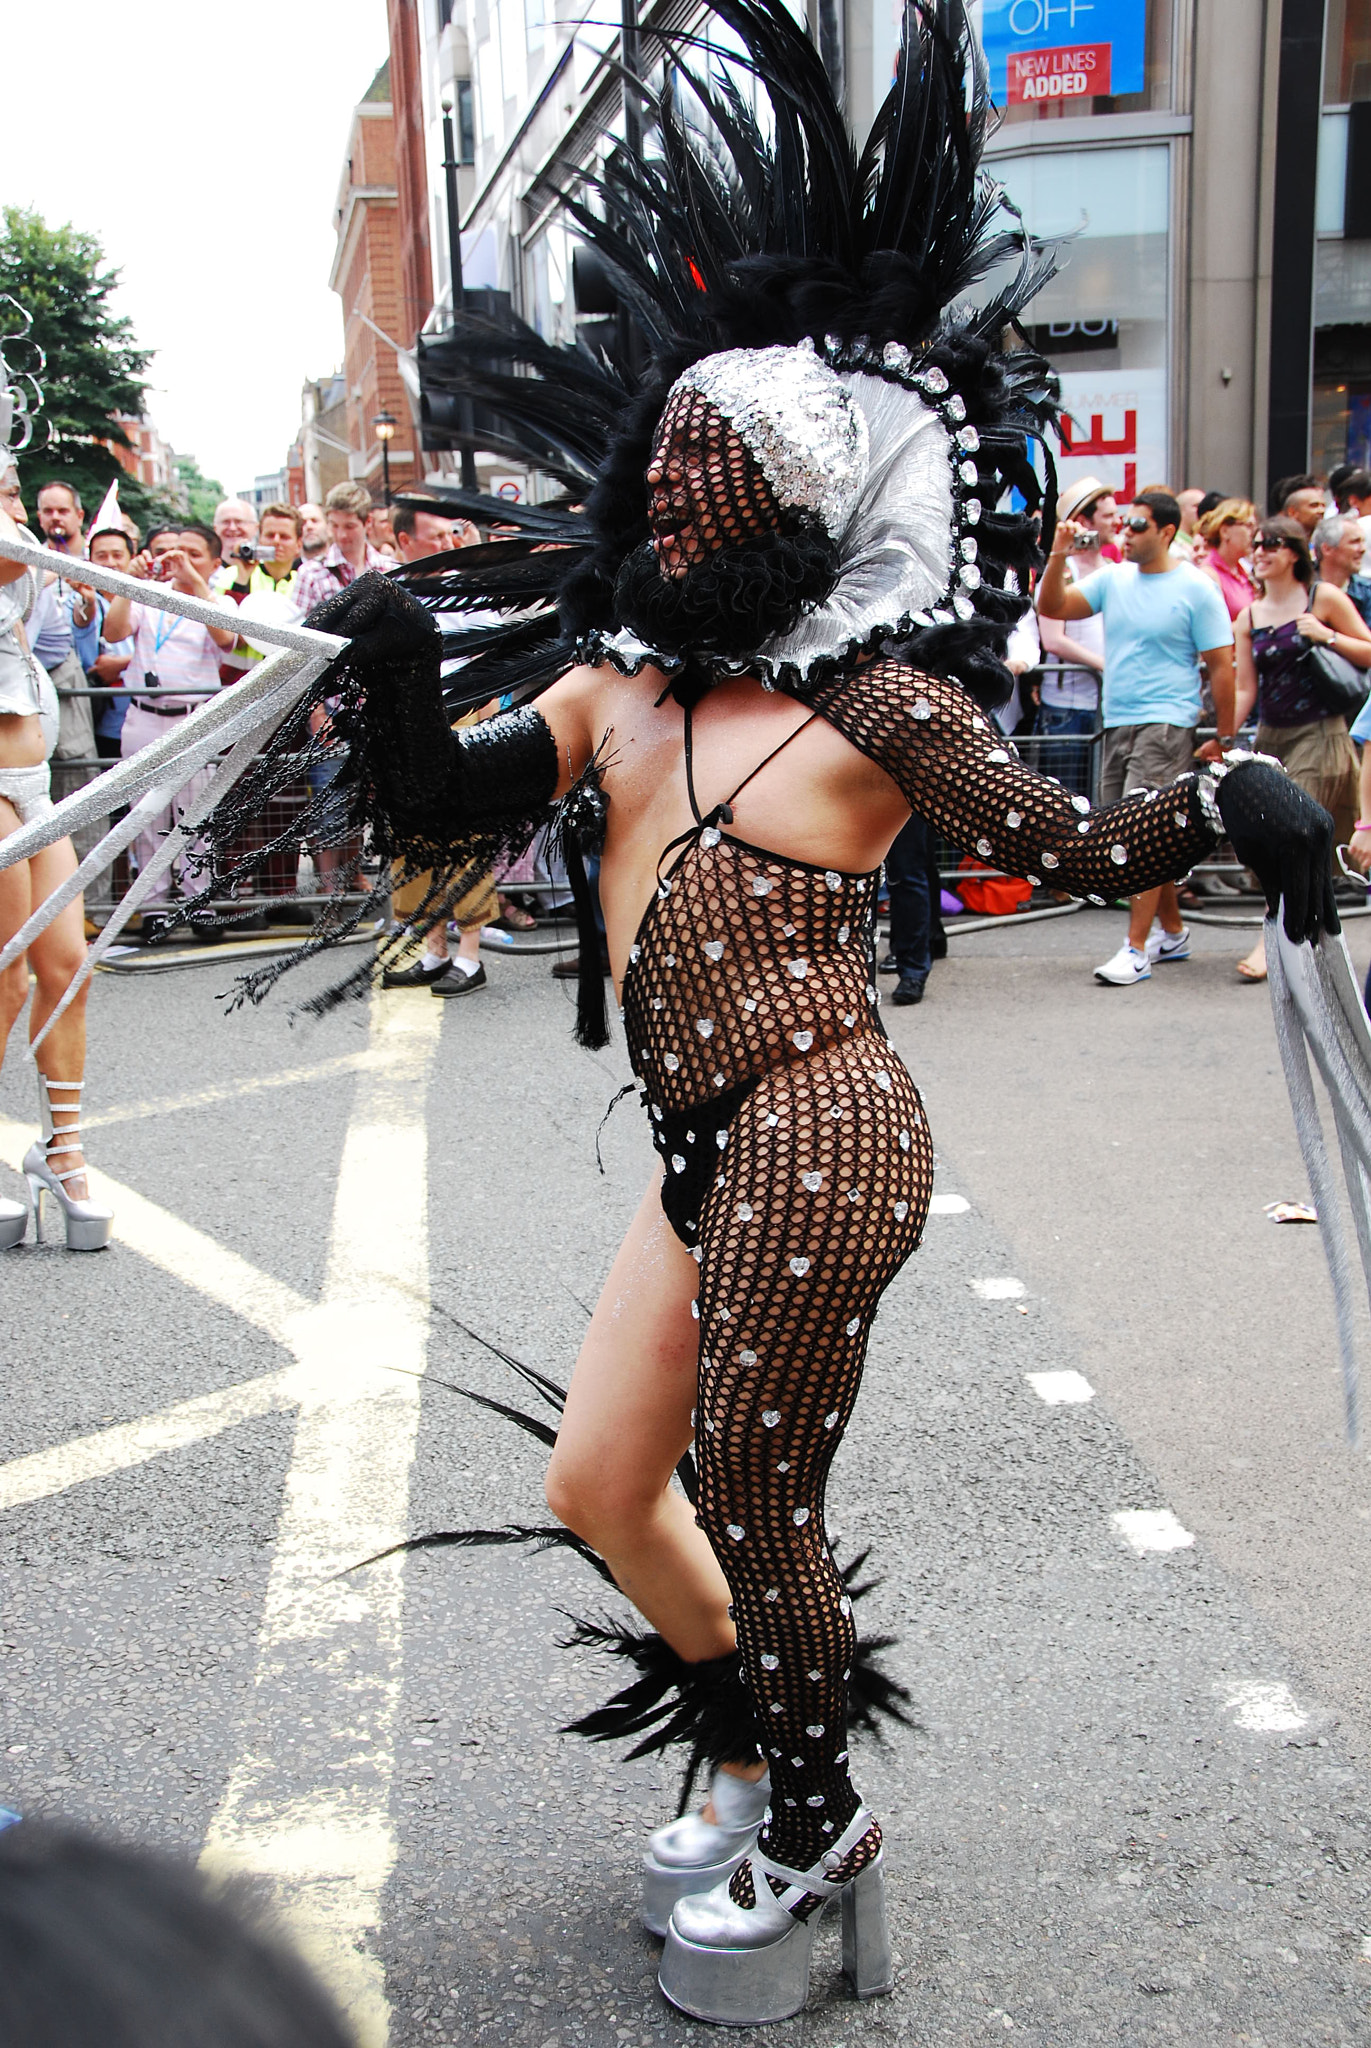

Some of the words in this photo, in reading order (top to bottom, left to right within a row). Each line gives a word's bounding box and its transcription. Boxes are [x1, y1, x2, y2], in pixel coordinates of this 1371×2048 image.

[1015, 56, 1049, 78] NEW
[1052, 50, 1097, 74] LINES
[1022, 71, 1088, 100] ADDED
